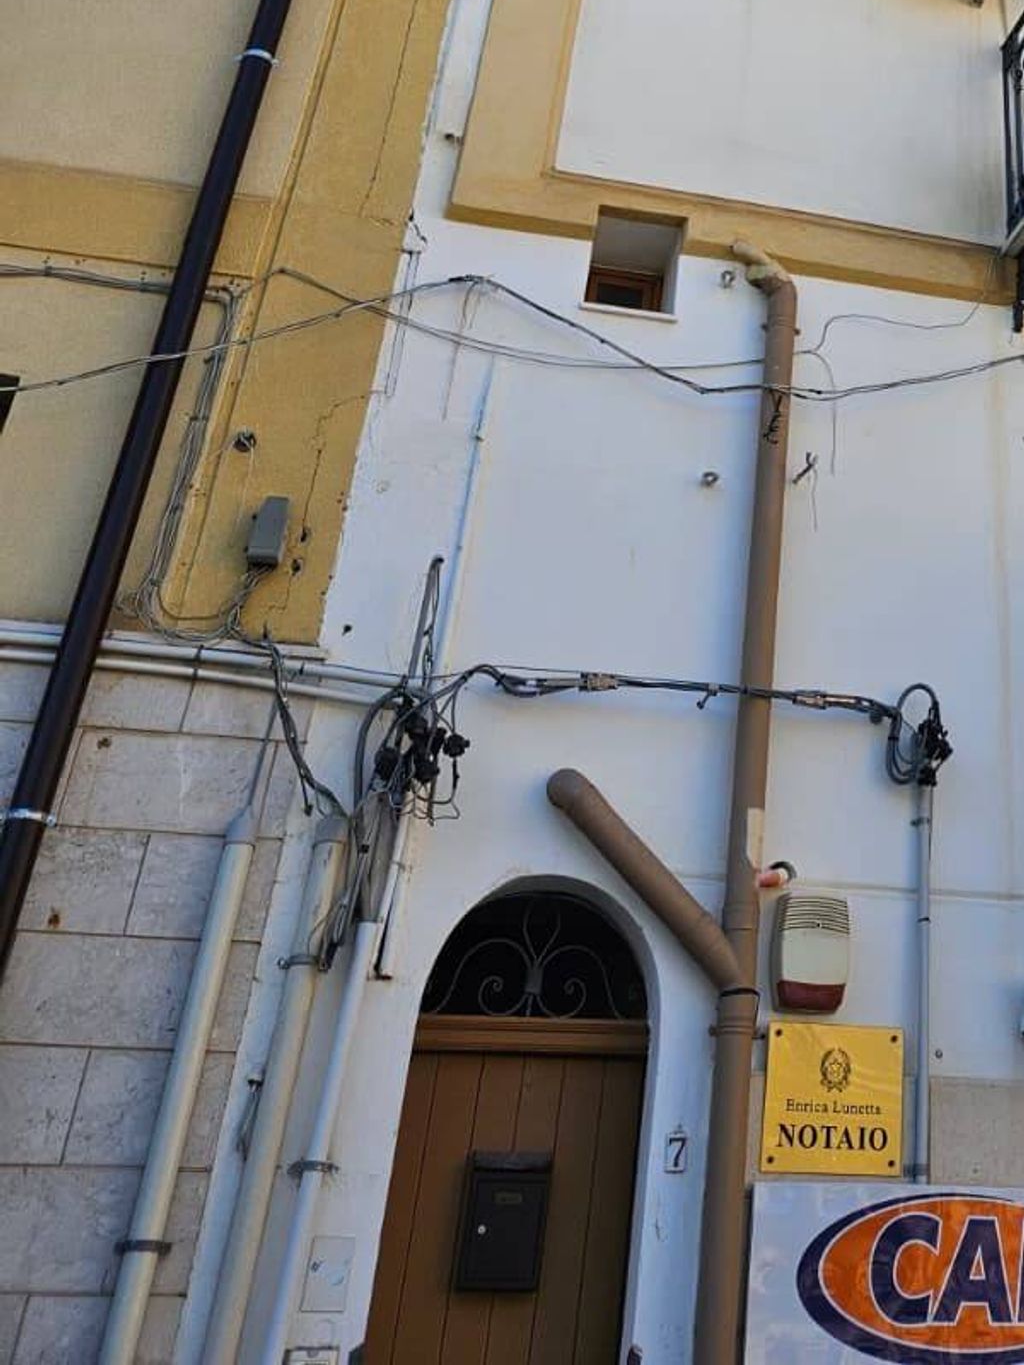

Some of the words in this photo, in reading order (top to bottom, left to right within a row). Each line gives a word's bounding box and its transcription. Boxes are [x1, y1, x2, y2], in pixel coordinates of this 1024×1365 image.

[785, 1098, 828, 1113] Enrica
[776, 1123, 888, 1152] NOTAIO
[669, 1137, 686, 1168] 7
